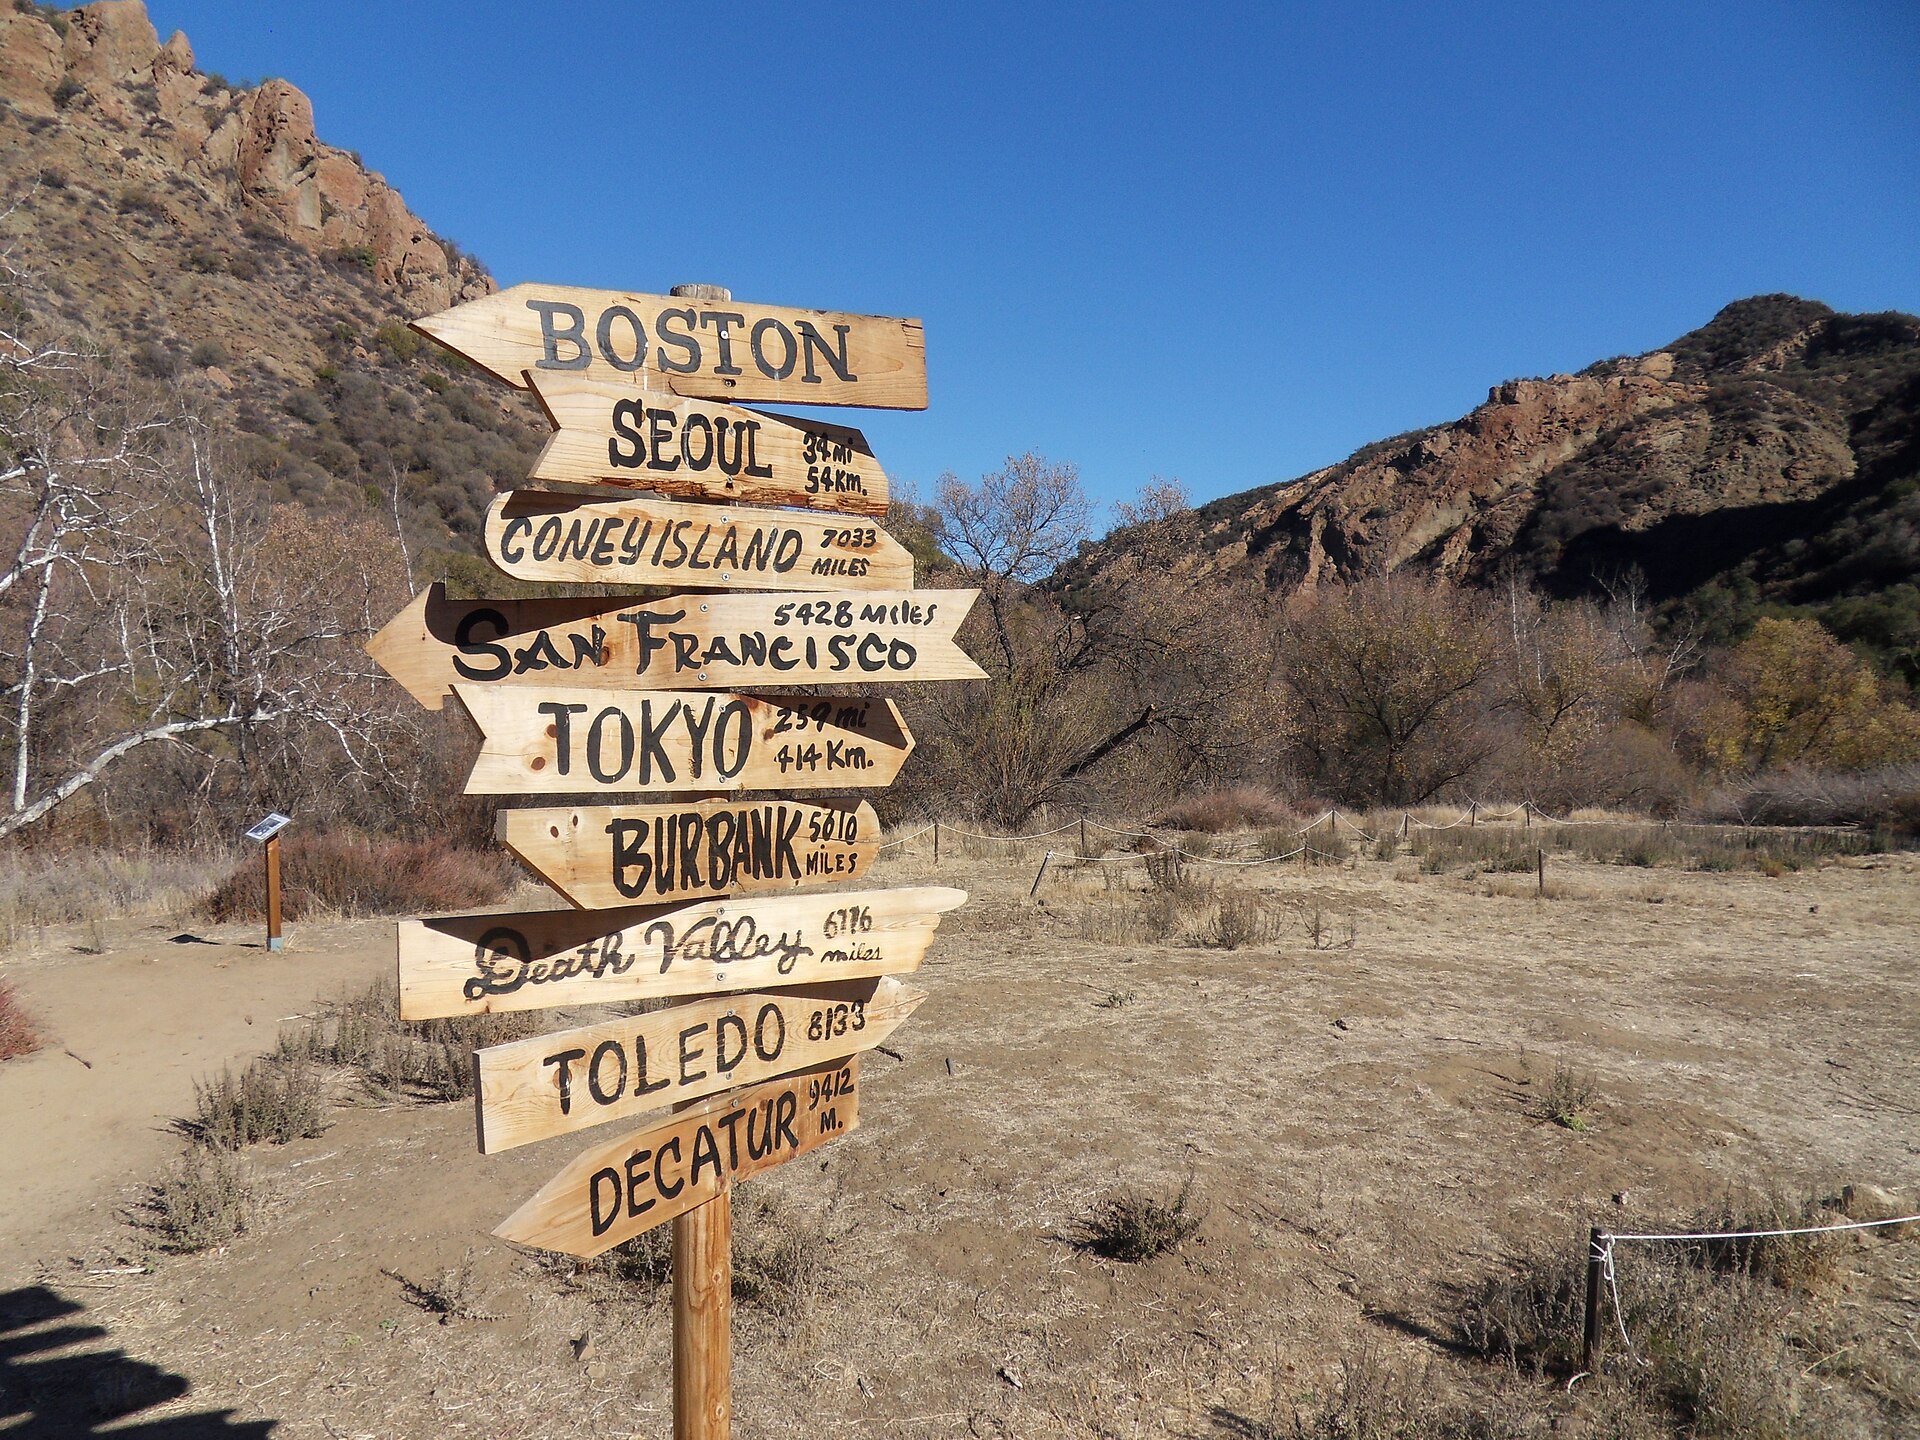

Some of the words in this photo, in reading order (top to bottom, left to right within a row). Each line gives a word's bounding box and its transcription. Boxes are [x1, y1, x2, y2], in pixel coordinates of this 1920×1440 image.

[526, 300, 858, 383] BOSTON
[609, 398, 773, 477] SEOUL
[820, 528, 877, 548] 7033
[811, 558, 870, 576] MILES
[774, 601, 853, 628] 5428
[452, 608, 605, 681] SAN
[617, 609, 917, 675] FRANCISCO
[774, 702, 831, 733] 259
[834, 702, 870, 728] mi
[538, 699, 752, 785] TOKYO
[774, 743, 822, 773] 414
[809, 801, 857, 845] 5610
[605, 806, 803, 898] BURBANK
[463, 926, 636, 1001] Death
[644, 916, 814, 974] Valley
[820, 942, 883, 962] miles
[808, 1000, 865, 1041] 8133
[543, 1003, 785, 1114] TOLEDO
[809, 1067, 854, 1111] 9412
[820, 1107, 843, 1134] M.
[589, 1091, 799, 1236] DECATUR
